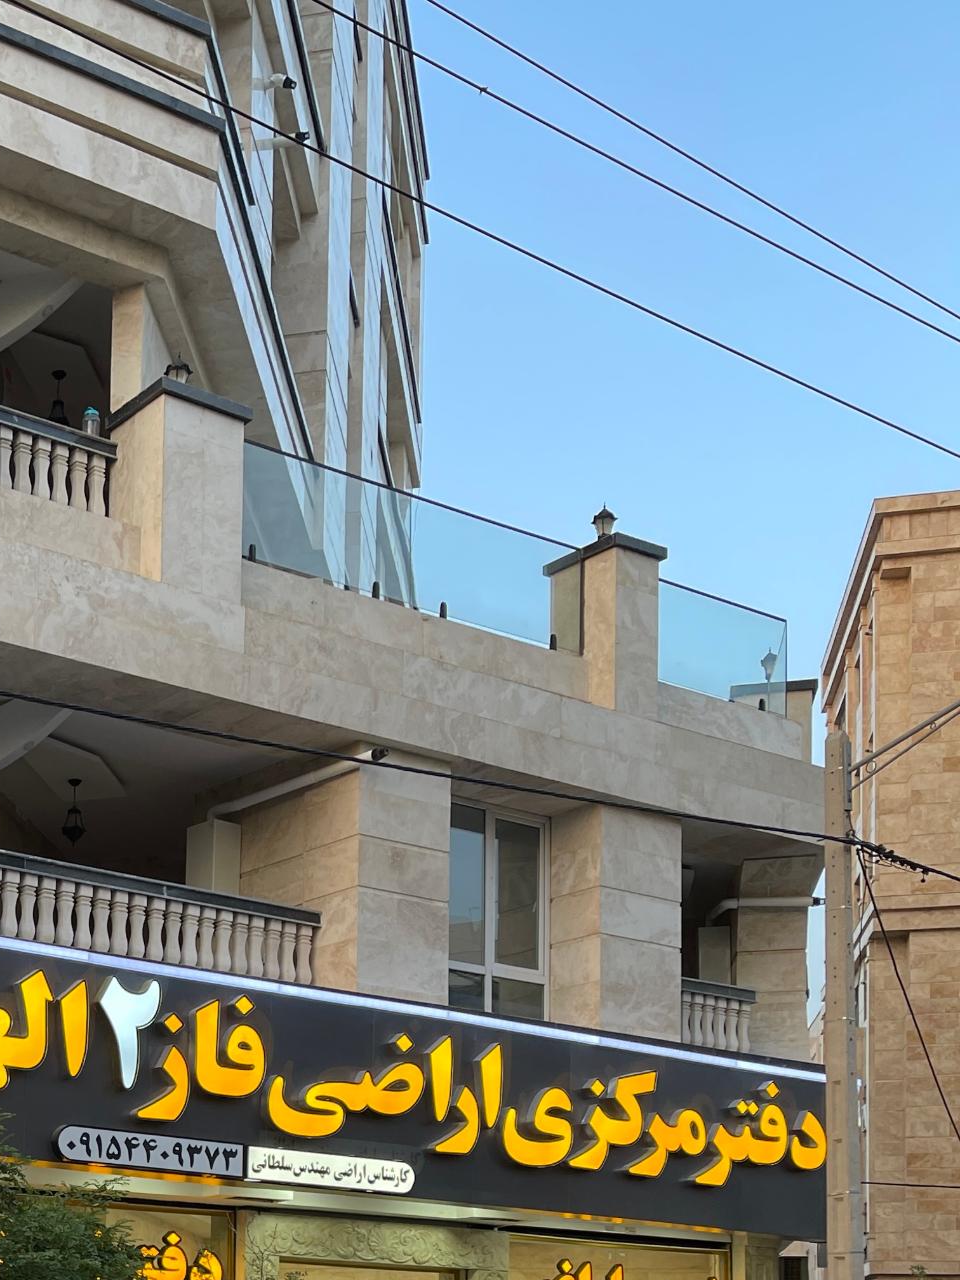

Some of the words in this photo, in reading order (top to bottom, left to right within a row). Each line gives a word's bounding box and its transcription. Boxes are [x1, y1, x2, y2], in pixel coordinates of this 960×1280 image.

[99, 976, 162, 1090] ۲
[137, 995, 266, 1121] فاز
[268, 1034, 502, 1155] اراضی
[503, 1070, 706, 1178] مرکزی
[66, 1131, 238, 1172] ۰۹۱۵۴۴۰۹۳۷۳
[251, 1153, 294, 1174] سلطانی
[292, 1161, 331, 1179] مهندس
[695, 1080, 828, 1187] دفتر
[333, 1162, 367, 1183] اراضی
[368, 1166, 411, 1188] کارشناس
